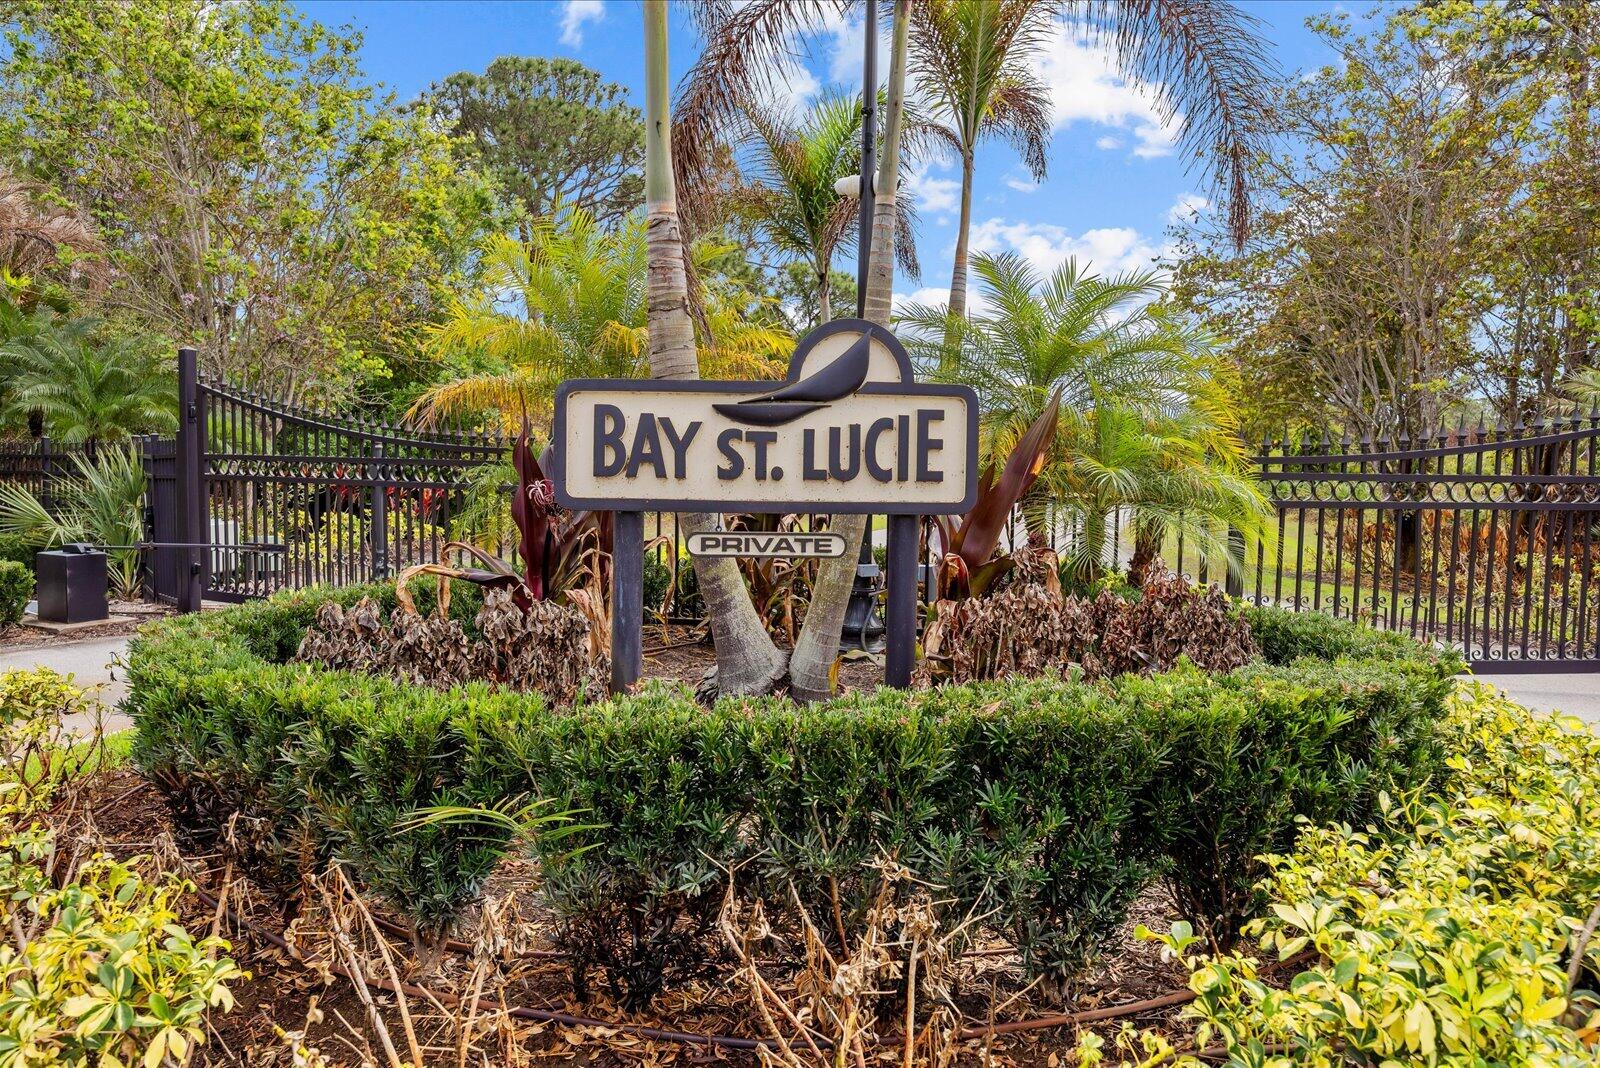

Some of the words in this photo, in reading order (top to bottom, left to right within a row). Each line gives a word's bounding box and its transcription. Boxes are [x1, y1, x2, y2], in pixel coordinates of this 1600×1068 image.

[593, 403, 702, 479] BAY
[716, 428, 784, 482] ST.
[803, 409, 945, 483] LUCIE
[700, 536, 833, 554] PRIVATE
